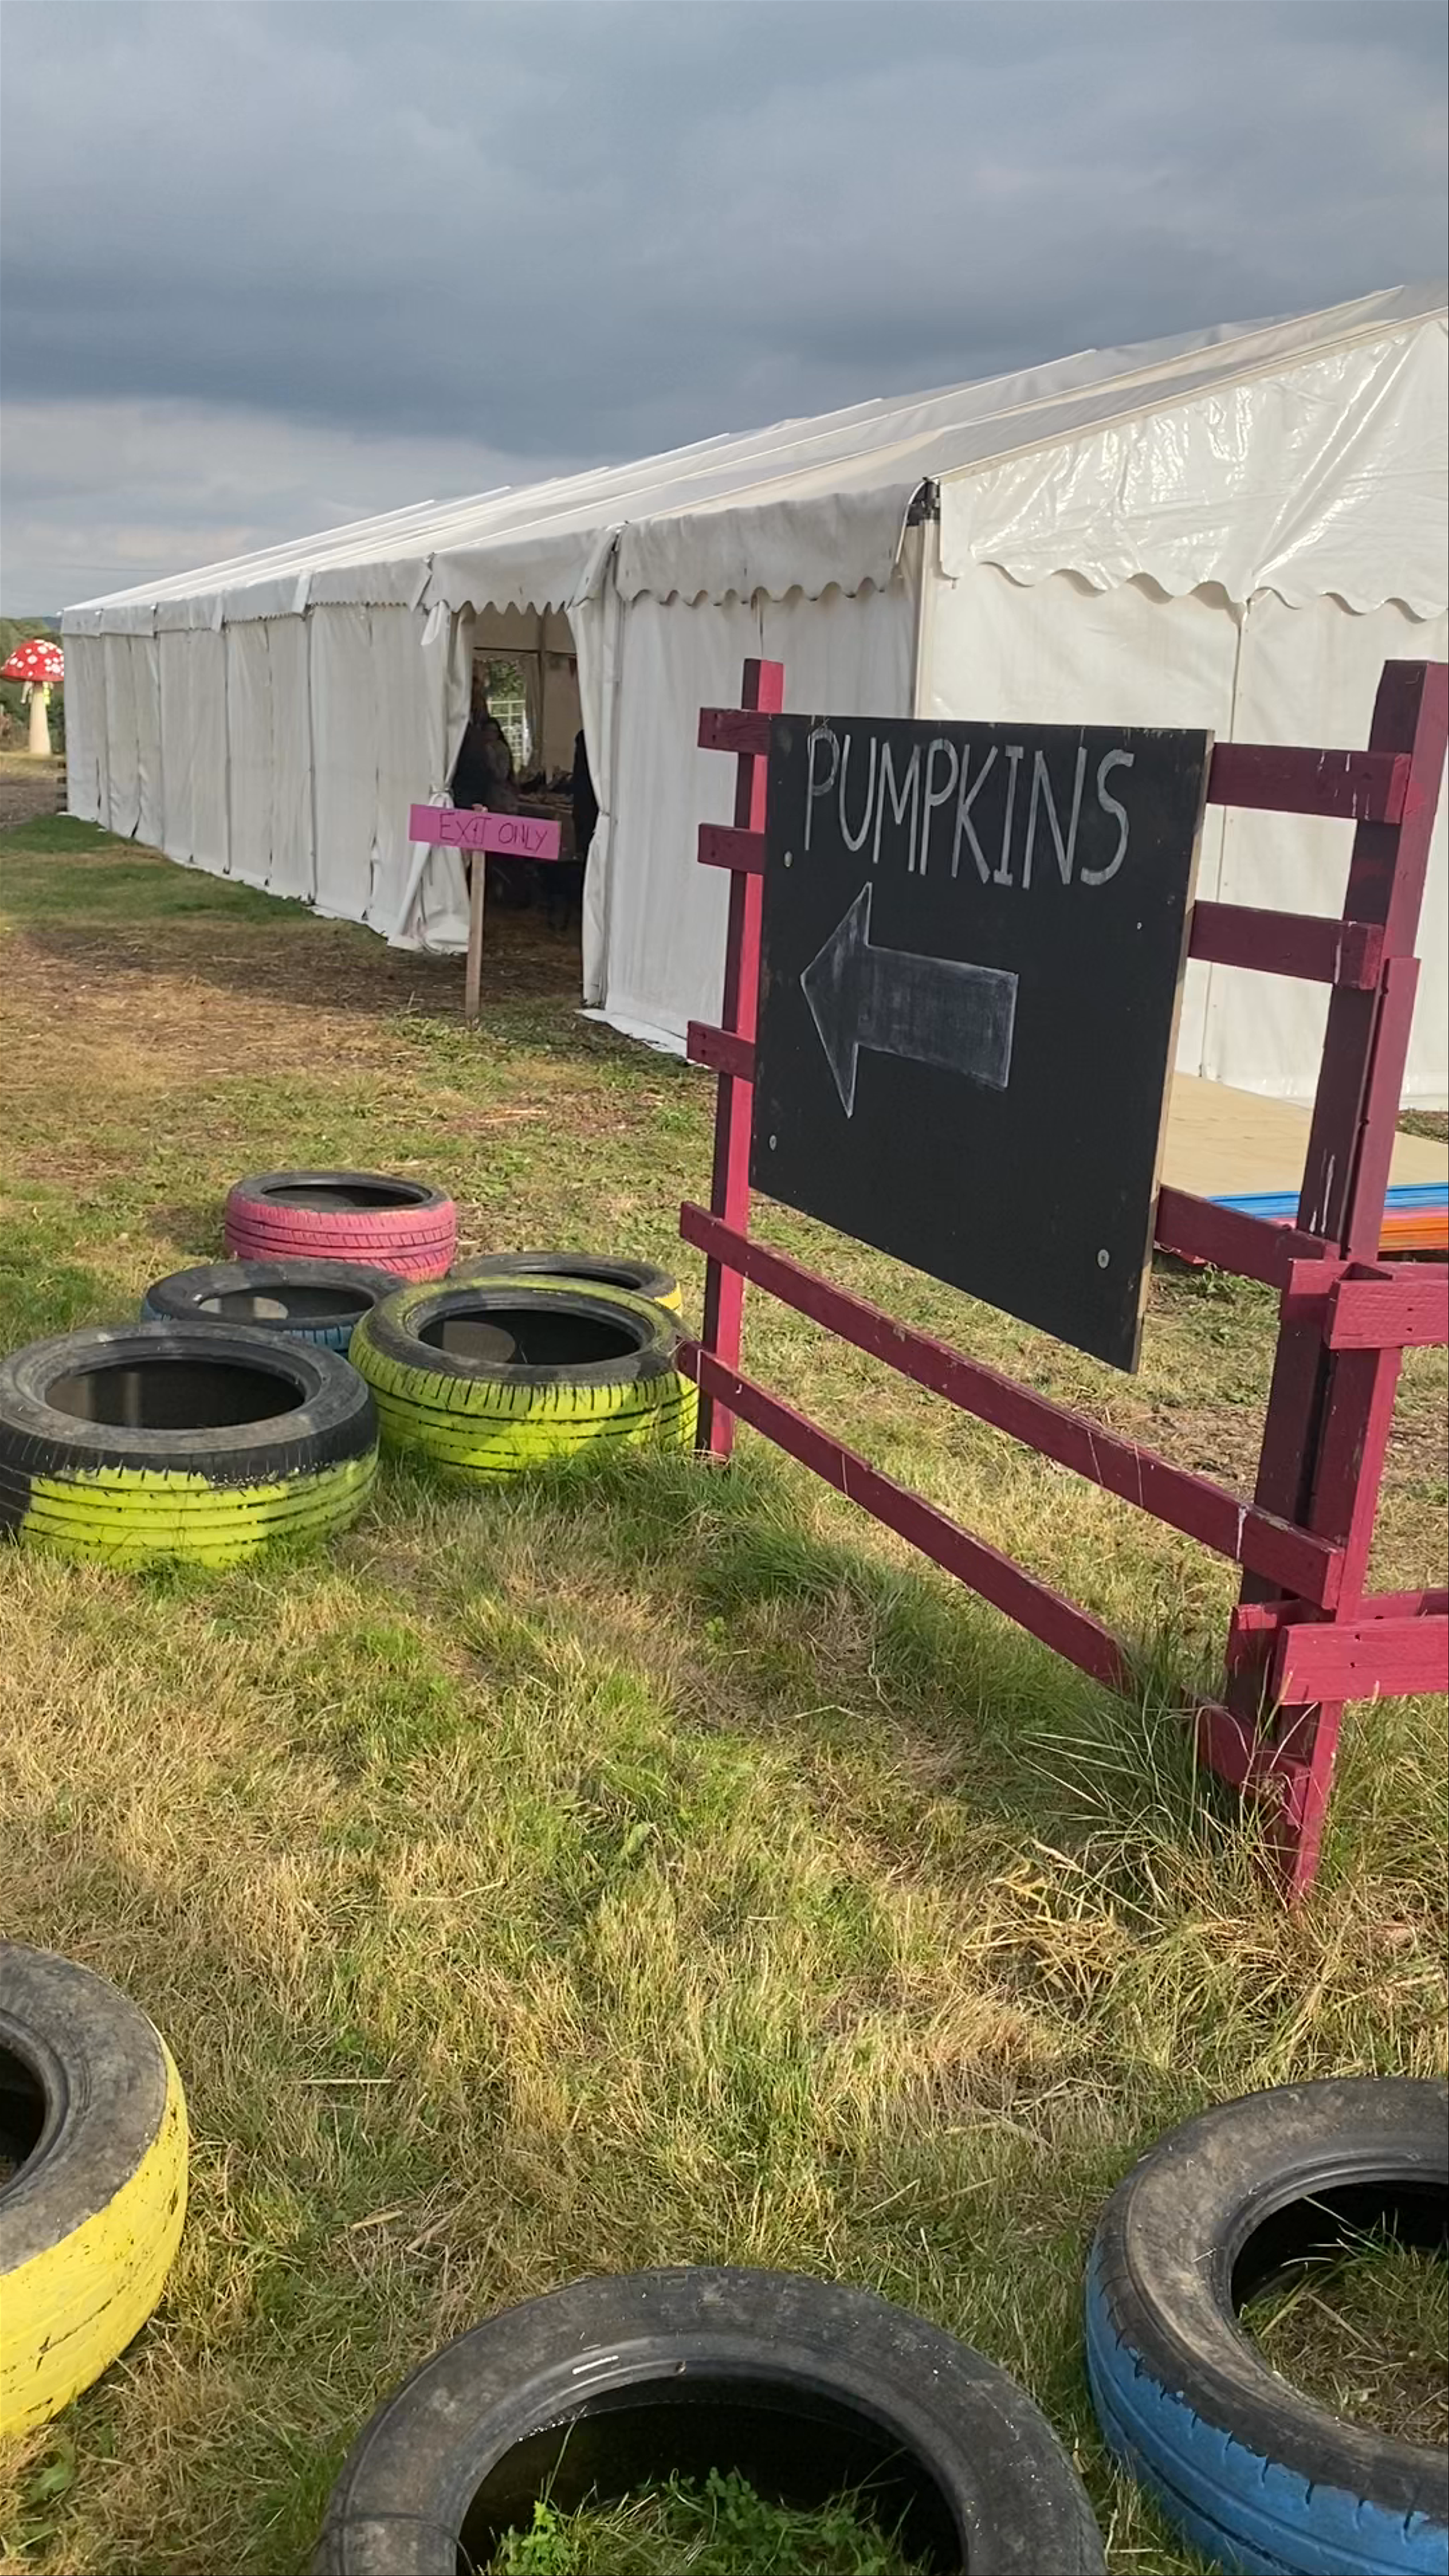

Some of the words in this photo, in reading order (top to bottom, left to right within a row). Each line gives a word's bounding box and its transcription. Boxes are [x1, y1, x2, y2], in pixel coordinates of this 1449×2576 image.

[440, 812, 492, 845] EXIT
[498, 823, 547, 852] ONLY
[804, 727, 1134, 889] PUMPKINS
